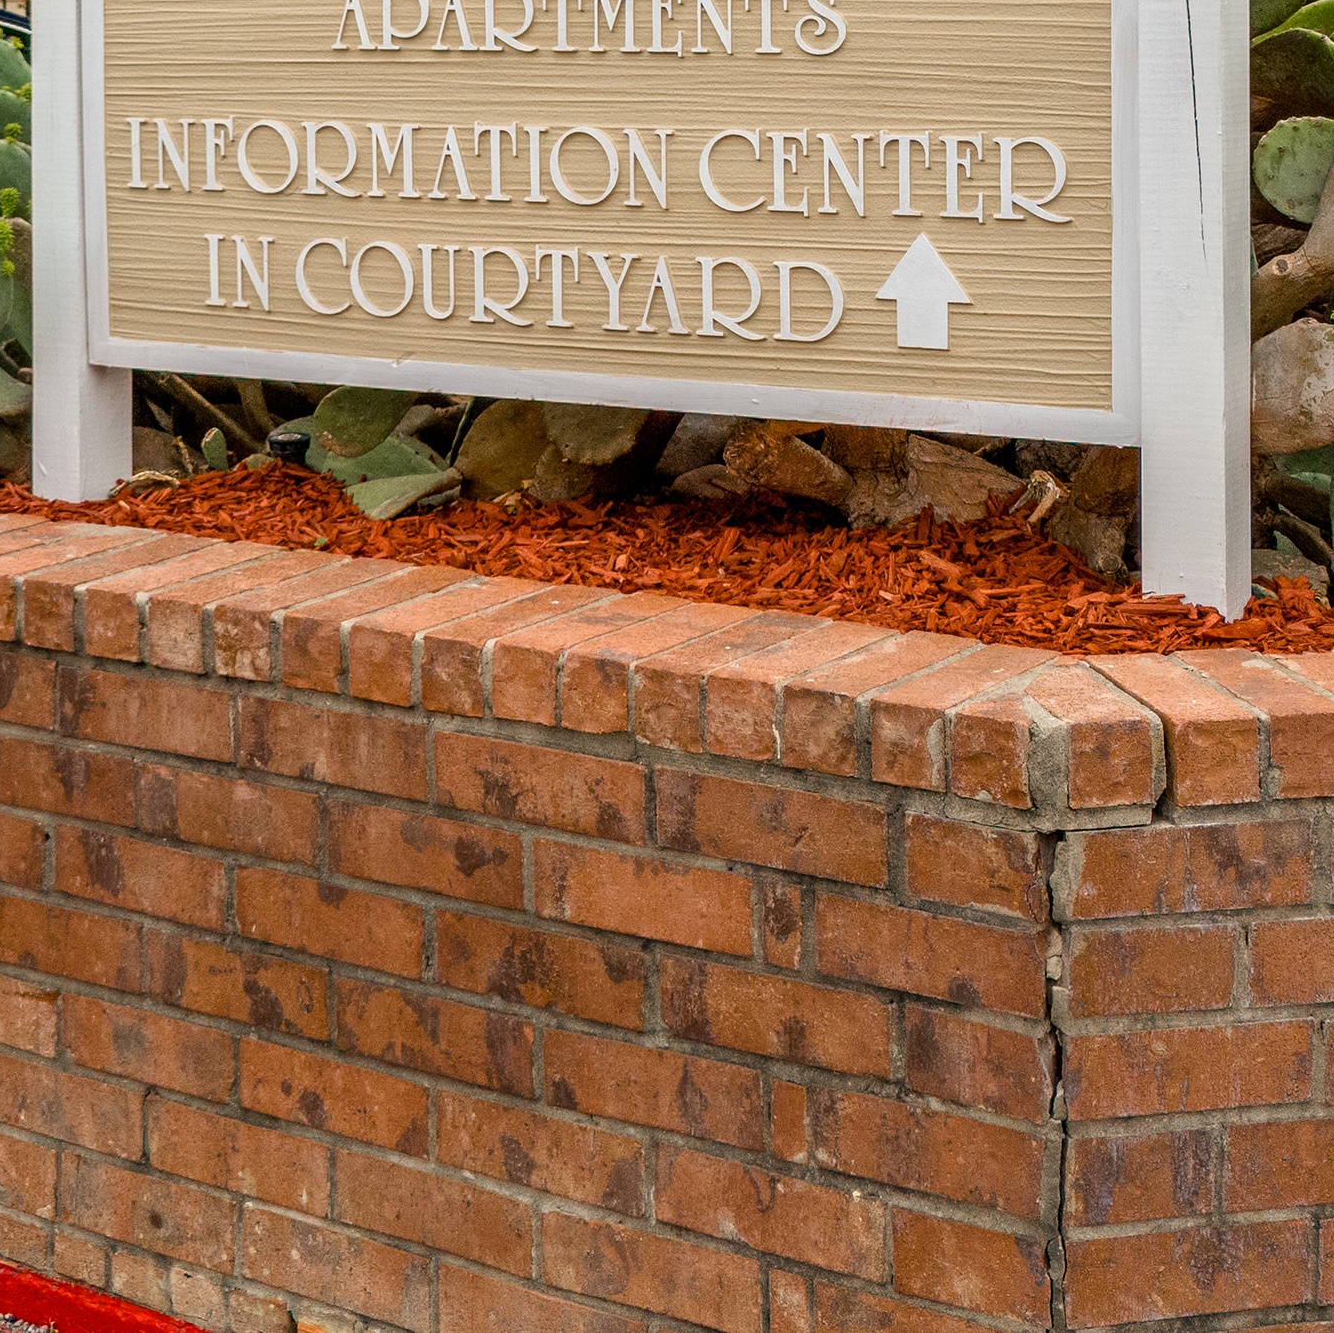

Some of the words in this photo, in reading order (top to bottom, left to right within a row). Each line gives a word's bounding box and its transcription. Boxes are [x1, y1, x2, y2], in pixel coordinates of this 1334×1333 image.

[126, 116, 672, 209] INFORMATION
[699, 127, 1071, 223] CENTER
[203, 234, 274, 311] IN
[295, 238, 844, 342] COURTYARD
